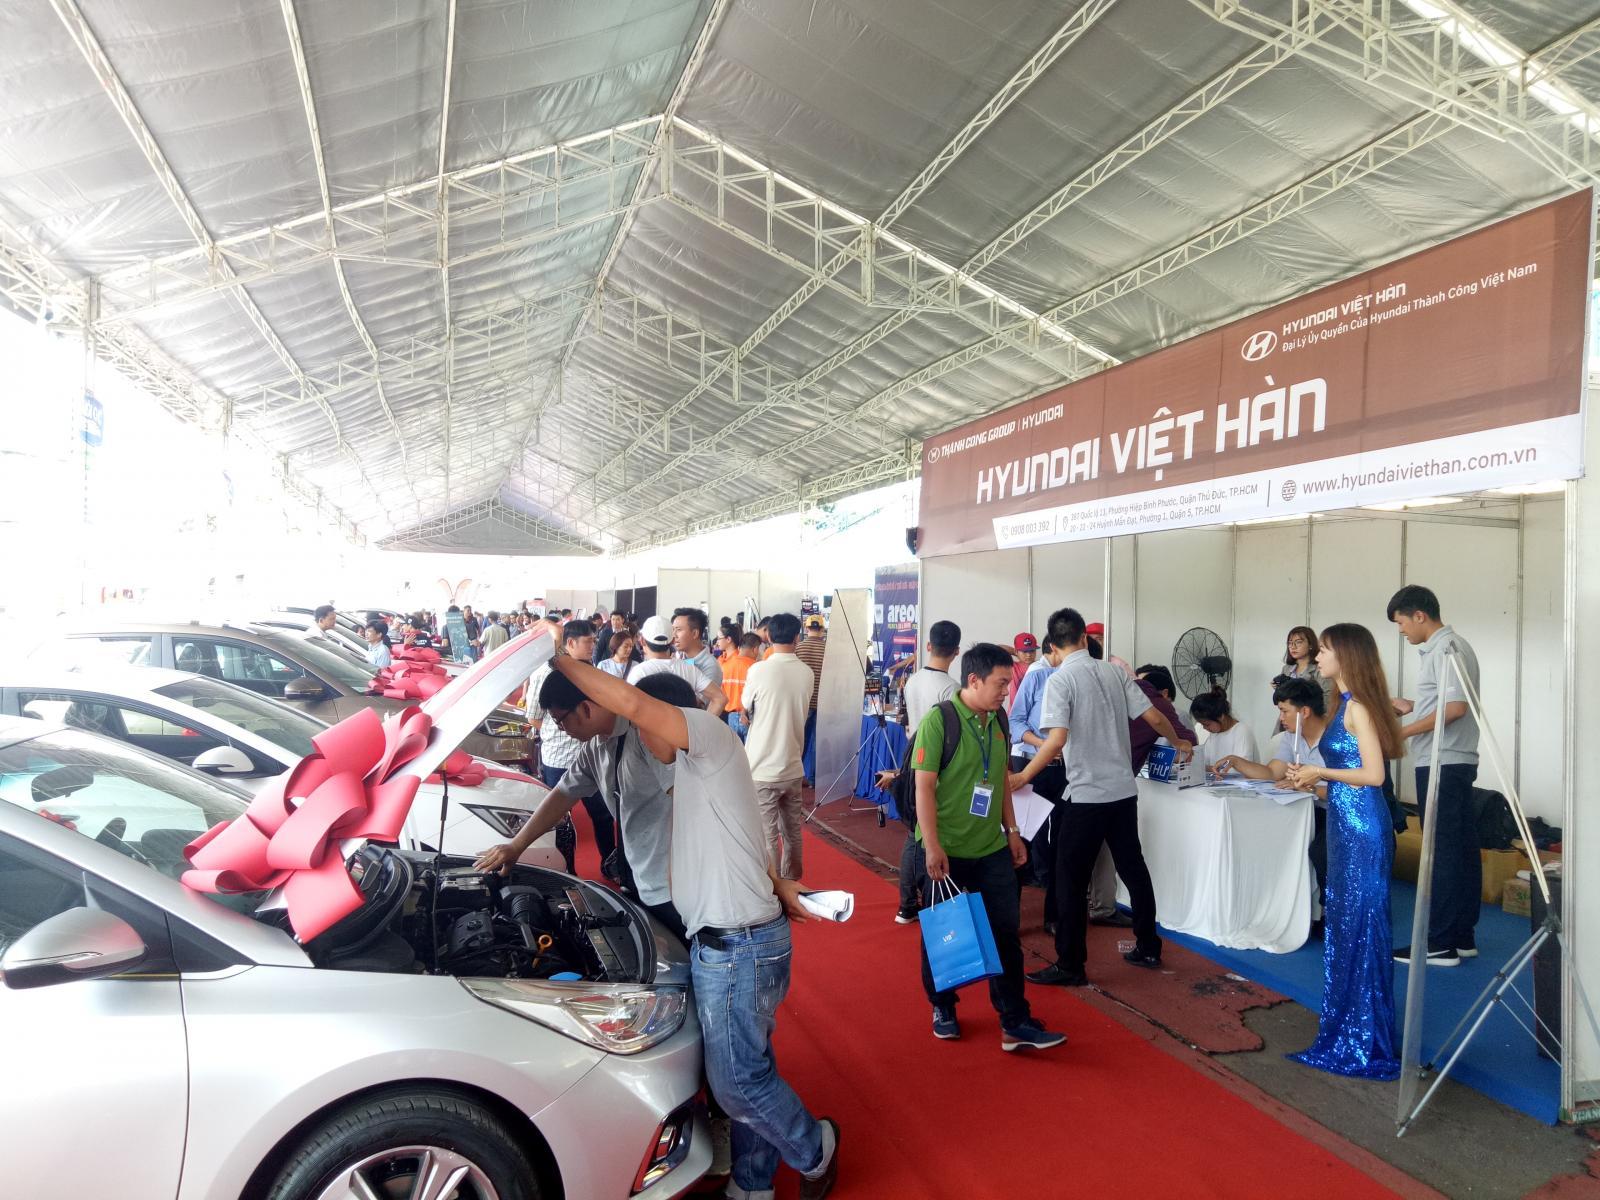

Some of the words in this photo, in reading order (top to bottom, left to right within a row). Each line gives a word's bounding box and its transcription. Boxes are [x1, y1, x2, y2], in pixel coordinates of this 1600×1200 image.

[1282, 340, 1296, 352] Đại
[1297, 335, 1307, 348] Lý
[1320, 322, 1349, 341] Quyền
[1350, 316, 1368, 331] Của
[1370, 301, 1411, 324] Hyundai
[1413, 290, 1446, 310] Thành
[1448, 281, 1478, 300] Công
[1480, 271, 1505, 289] Việt
[1507, 263, 1538, 281] Nam
[1283, 306, 1338, 336] HYUNDAI
[1341, 294, 1373, 315] VIỆT
[1375, 282, 1406, 305] HÀN
[1022, 403, 1064, 430] HYUNDAI
[976, 437, 1100, 505] HYUNDAI
[1110, 406, 1205, 482] VIỆT
[1215, 374, 1328, 454] HÀN
[987, 420, 1016, 442] GROUP
[1302, 447, 1537, 495] www.hyundaiviethan.com.vn
[1179, 493, 1197, 505] Quận
[1229, 483, 1258, 497] TP.HCM
[1194, 503, 1221, 516] TP.HCM
[1025, 521, 1037, 534] 003
